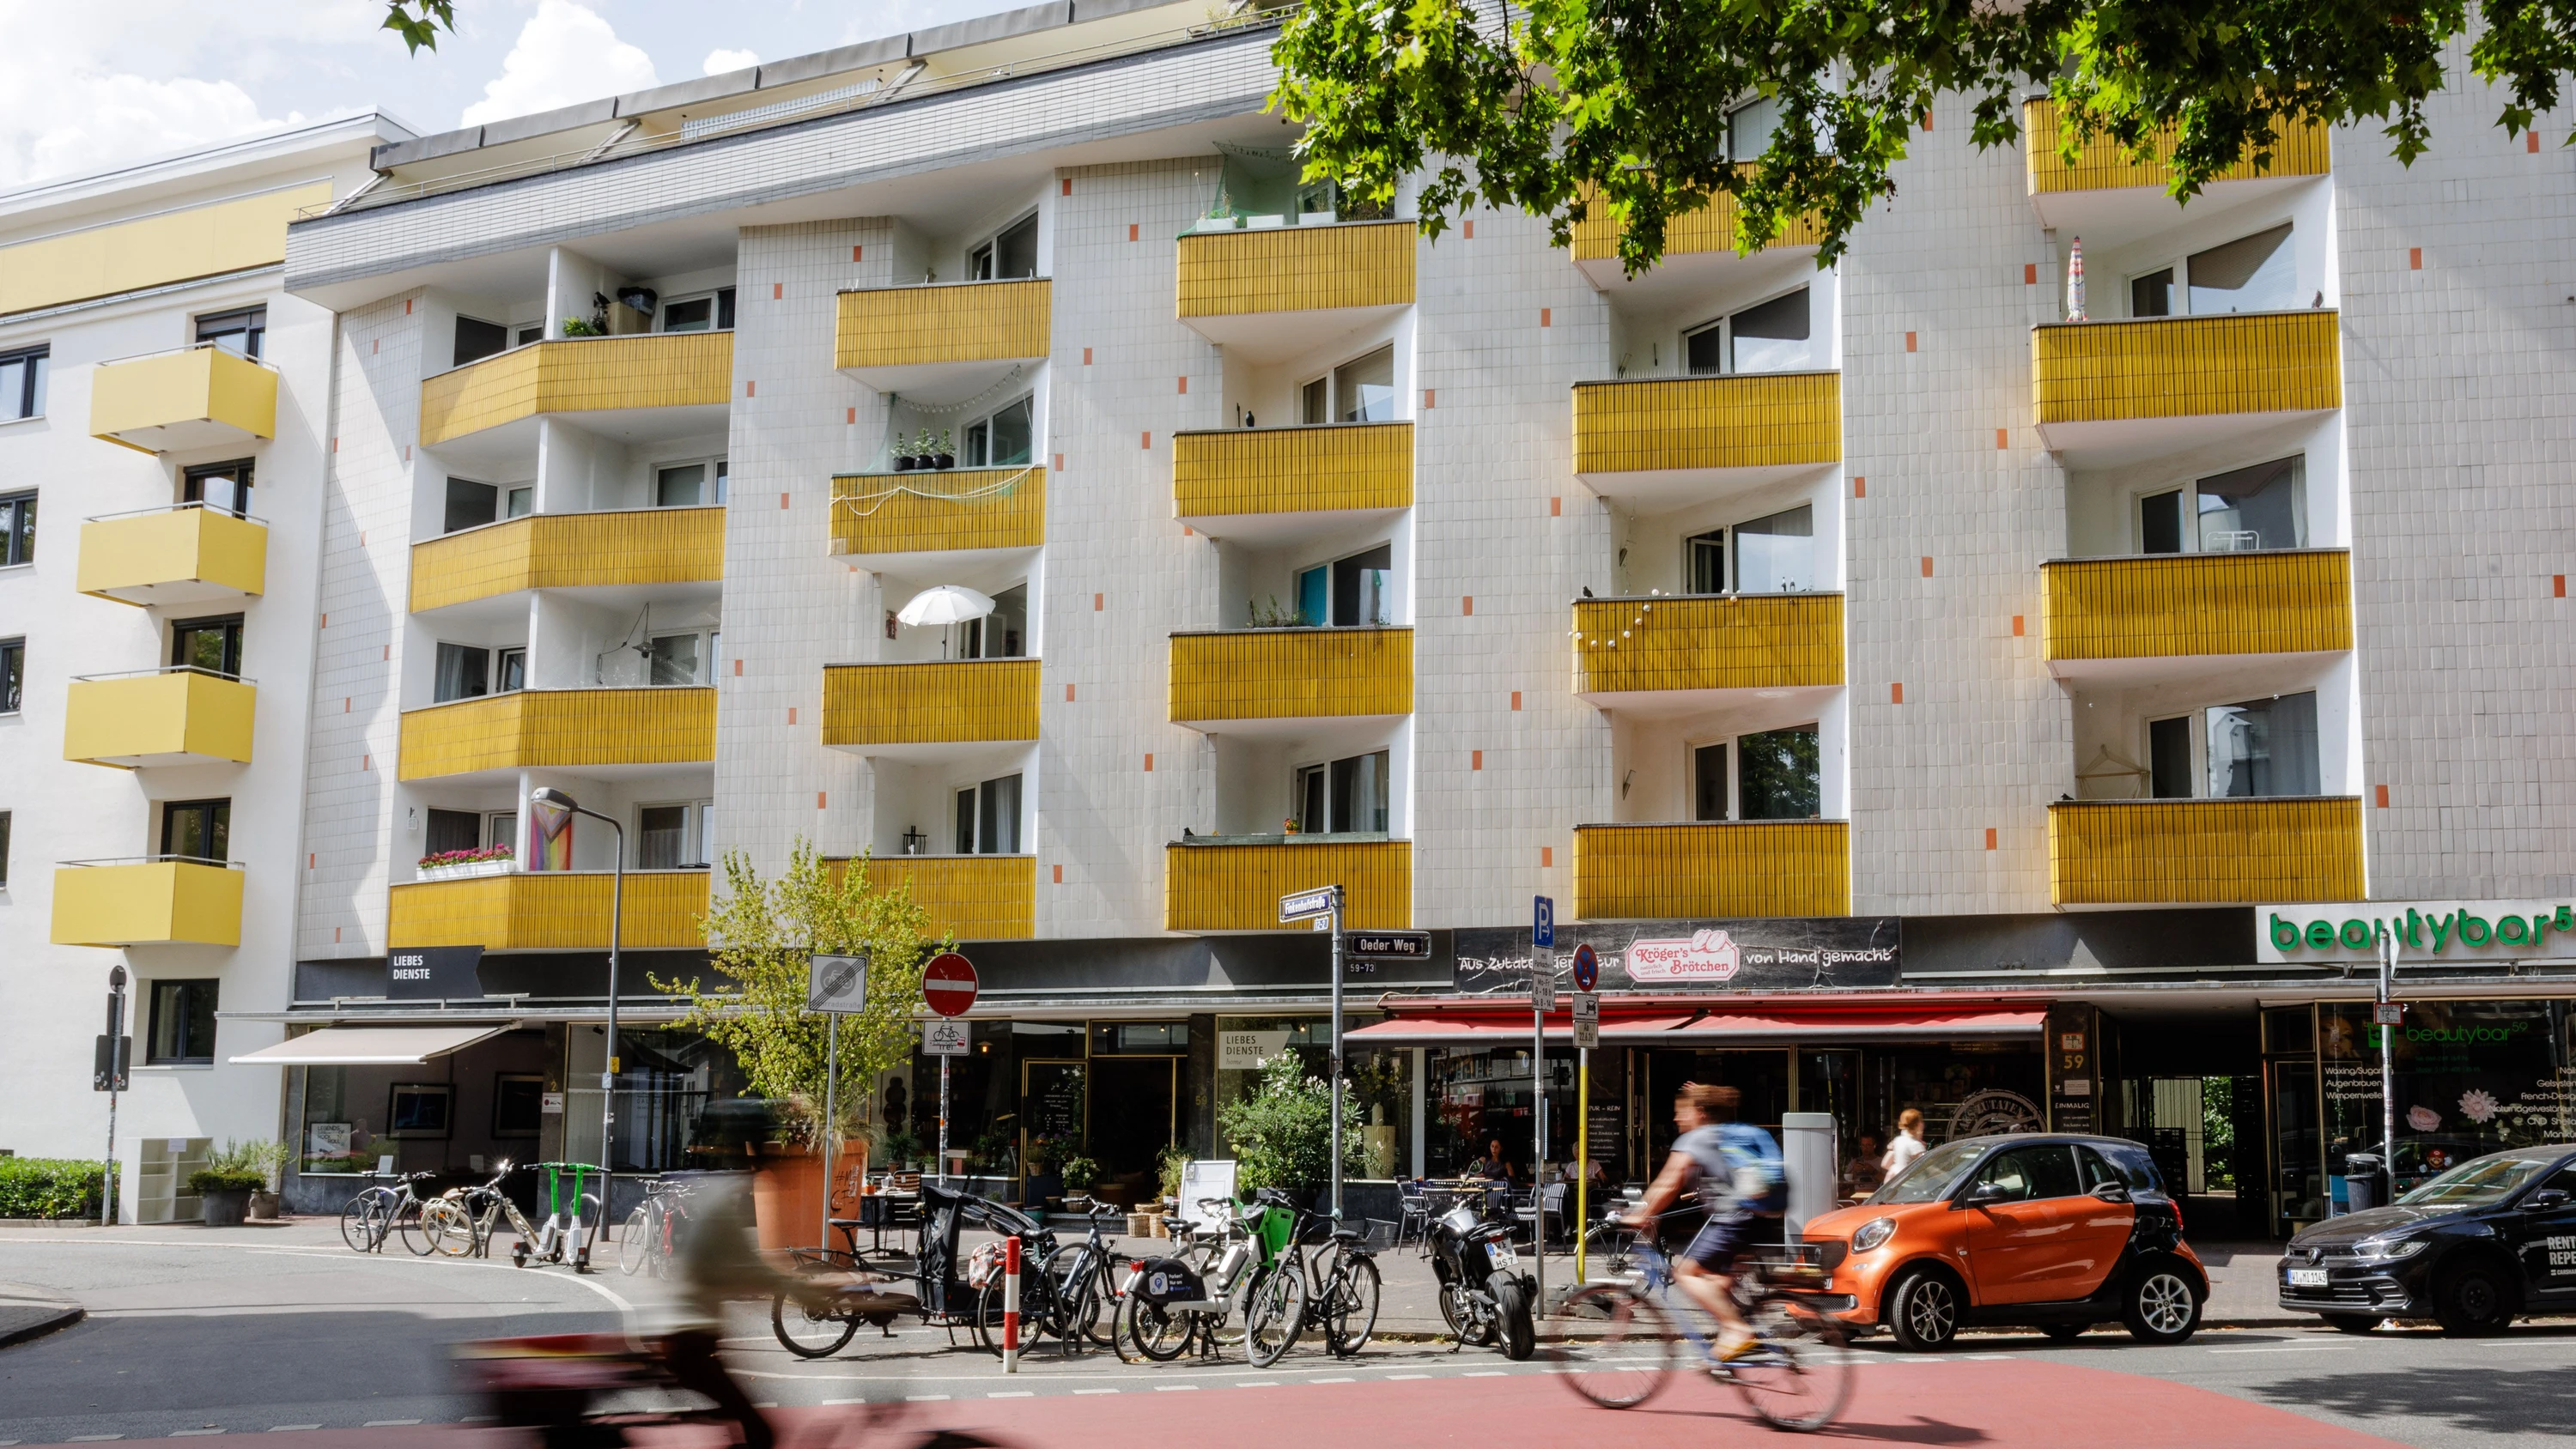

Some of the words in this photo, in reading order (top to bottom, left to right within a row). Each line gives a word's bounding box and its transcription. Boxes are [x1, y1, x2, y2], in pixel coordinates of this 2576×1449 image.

[1538, 902, 1549, 940] P
[1360, 938, 1390, 951] Oeder
[1394, 939, 1416, 954] Weg
[1636, 947, 1689, 963] Kröger's
[1746, 953, 1774, 964] von
[1778, 949, 1818, 964] Hand
[1822, 947, 1893, 967] gemacht
[393, 955, 423, 967] LIEBES
[1460, 958, 1483, 971] Aus
[1487, 956, 1534, 970] Zutate
[1350, 963, 1375, 973] 59-73
[1670, 960, 1729, 974] Brötchen
[392, 968, 430, 979] DIENSTE
[1226, 1035, 1256, 1045] LIEBES
[1226, 1046, 1264, 1055] DIENSTE
[2064, 1055, 2084, 1070] 59
[550, 1081, 557, 1092] 2
[2325, 1080, 2383, 1088] Augenbrauen
[2325, 1092, 2384, 1100] Wimpernwelle
[2527, 1117, 2548, 1125] CND
